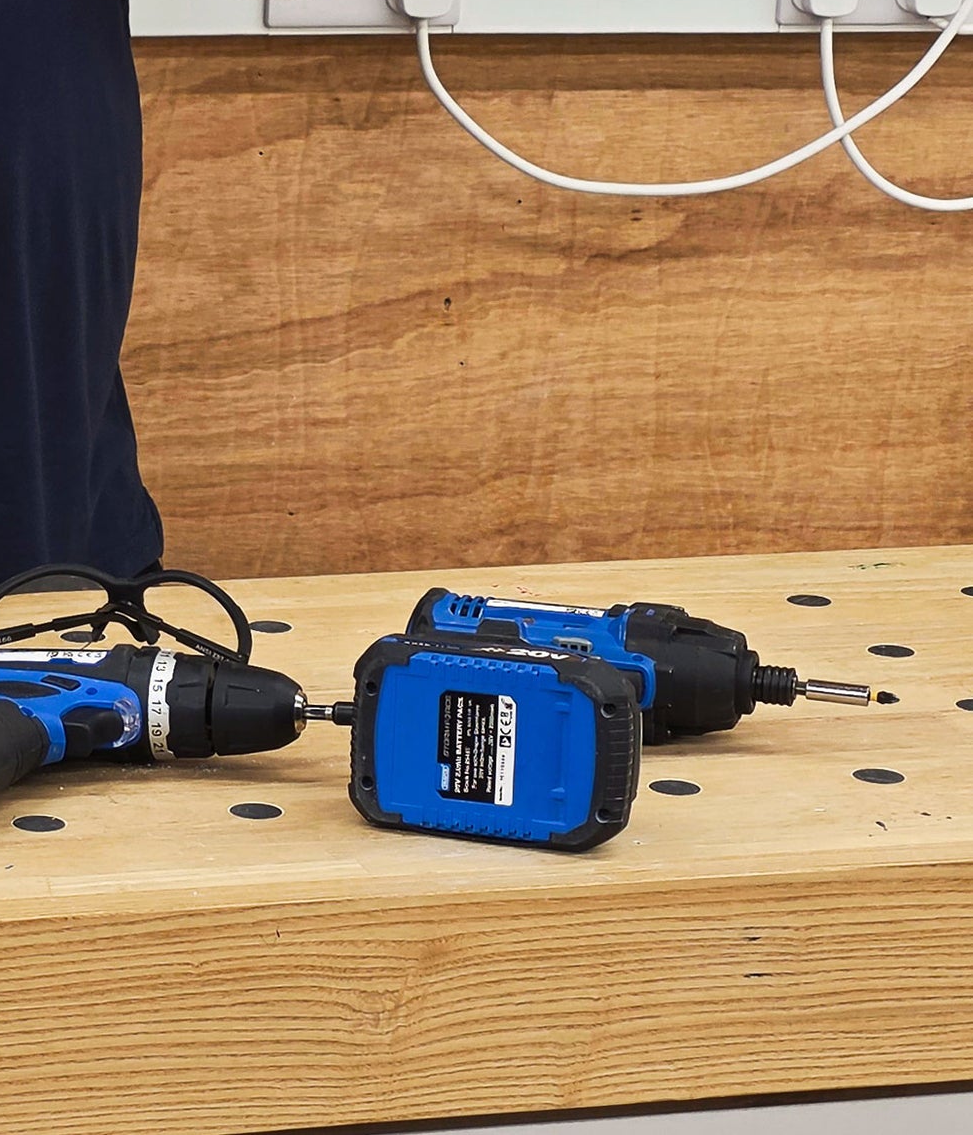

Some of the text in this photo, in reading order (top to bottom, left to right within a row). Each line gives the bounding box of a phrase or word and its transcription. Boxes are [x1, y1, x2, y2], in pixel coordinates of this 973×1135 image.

[156, 661, 167, 672] 13
[153, 679, 164, 693] 15
[152, 700, 162, 715] 17
[151, 722, 162, 737] 19
[153, 743, 165, 753] 21
